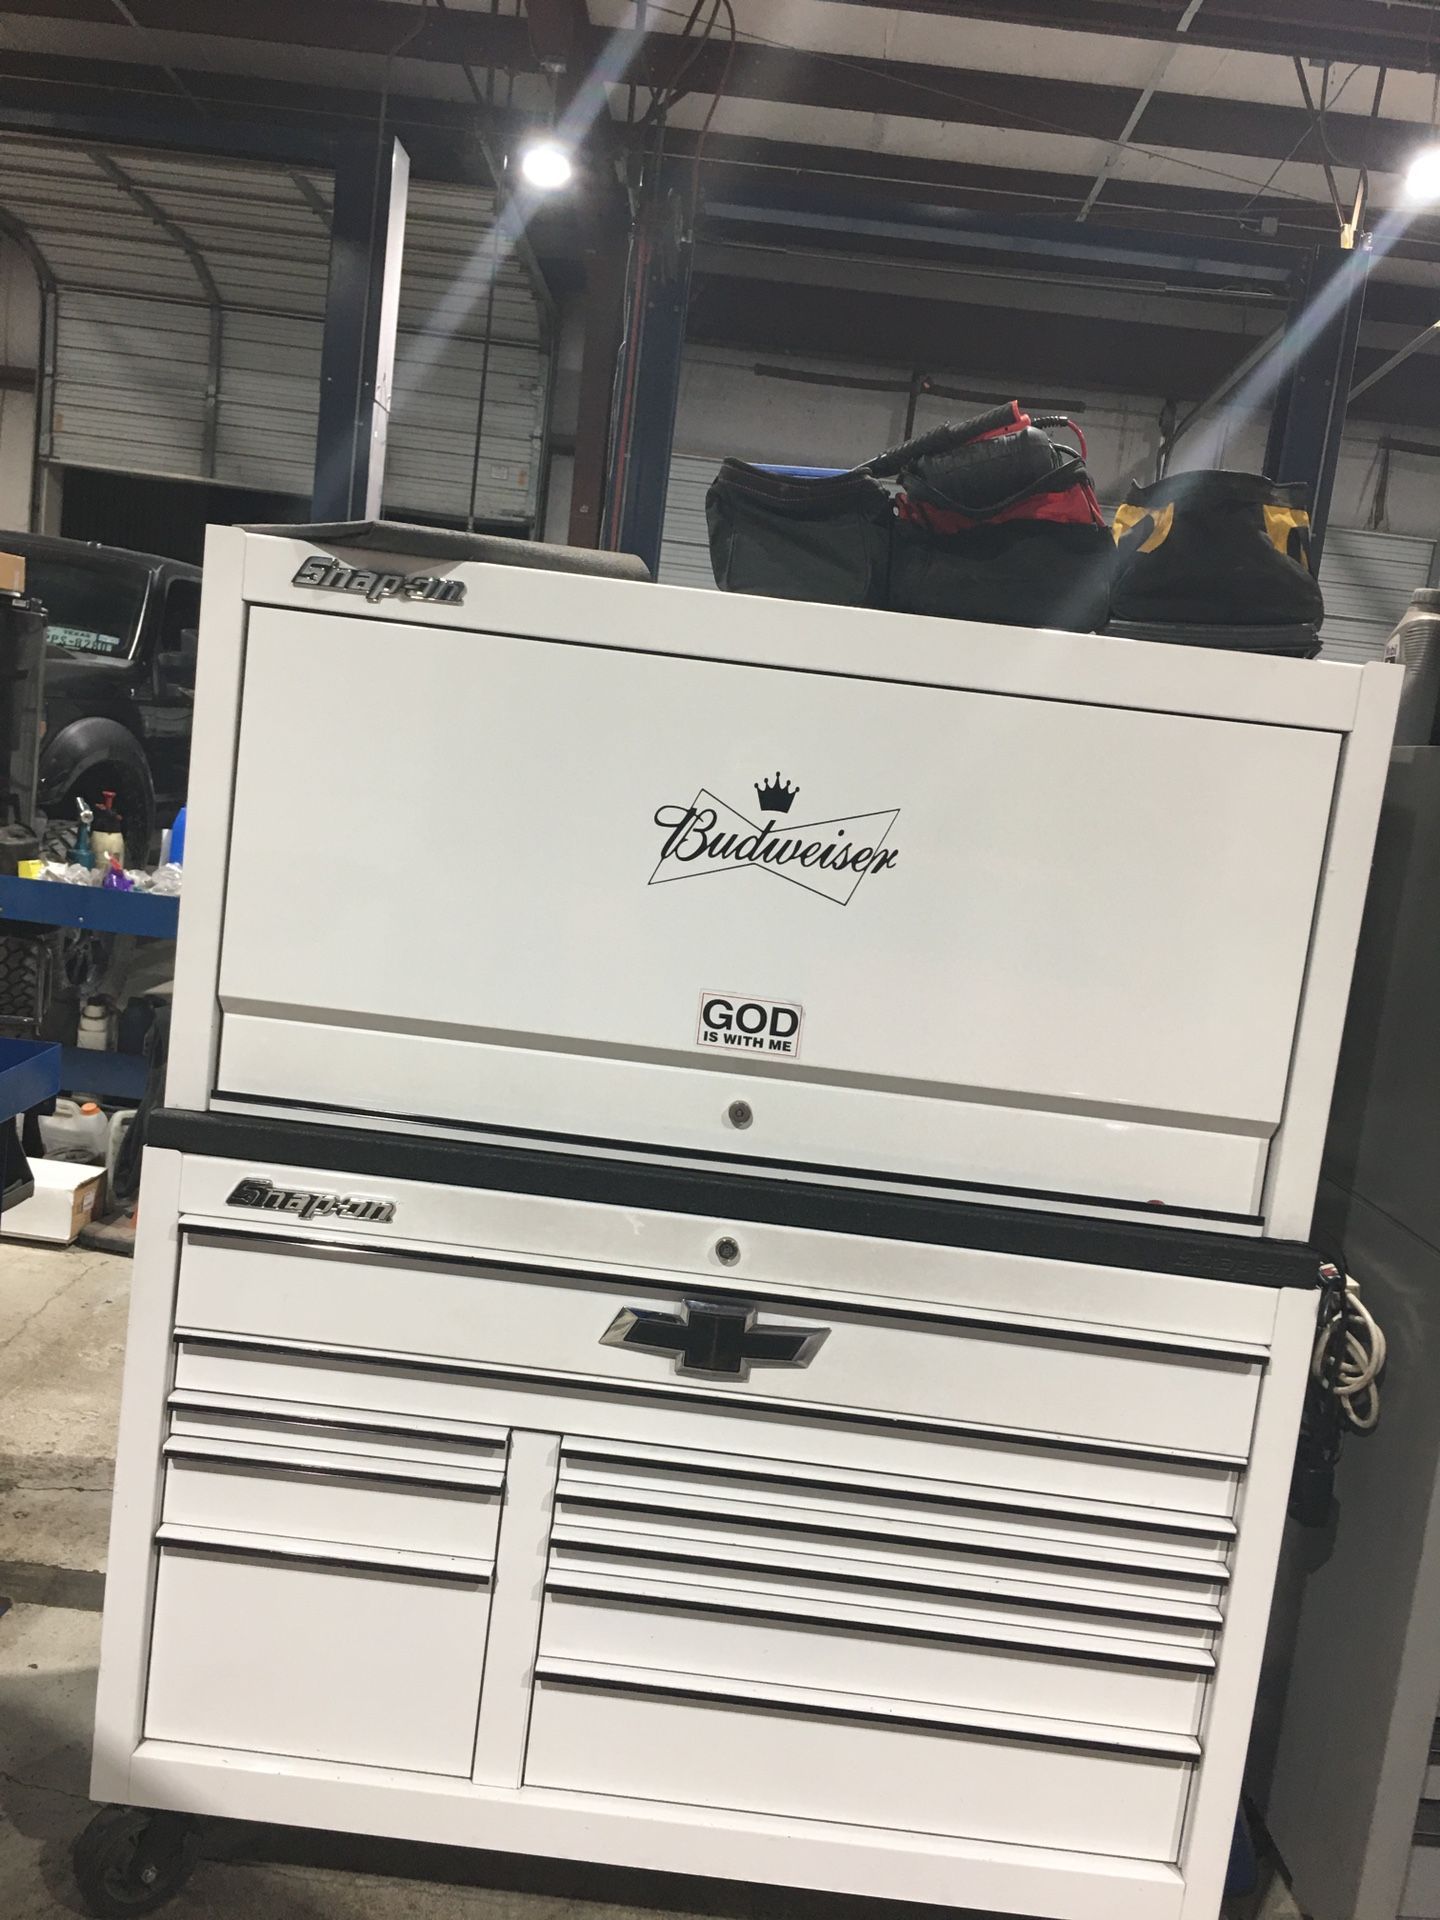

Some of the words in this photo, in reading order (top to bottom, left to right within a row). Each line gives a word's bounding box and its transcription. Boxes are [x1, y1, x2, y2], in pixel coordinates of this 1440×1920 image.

[292, 556, 466, 604] Snap-on
[654, 805, 898, 874] Budweiser
[703, 999, 799, 1037] GOD
[703, 1031, 718, 1042] IS
[724, 1033, 763, 1049] WITH
[769, 1039, 792, 1052] ME
[226, 1177, 396, 1223] Snap-on
